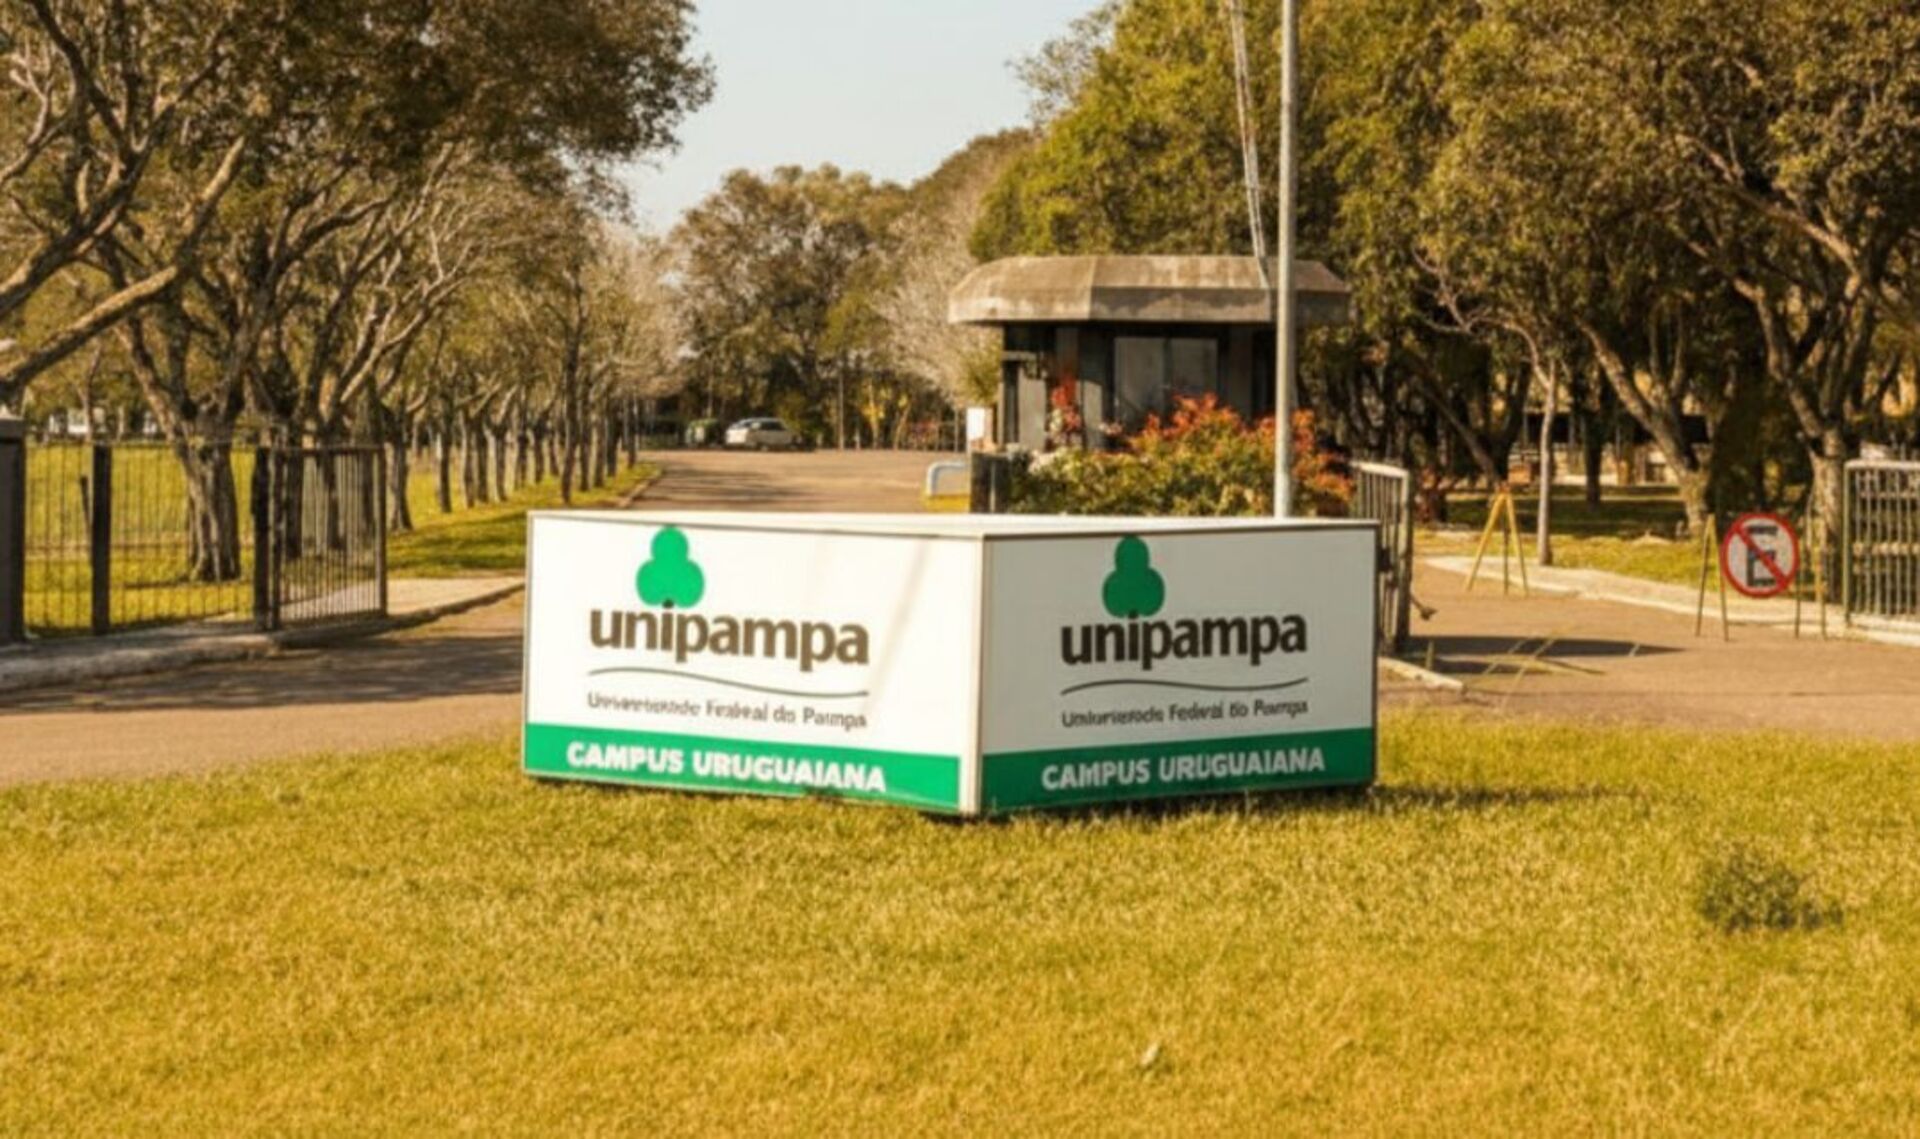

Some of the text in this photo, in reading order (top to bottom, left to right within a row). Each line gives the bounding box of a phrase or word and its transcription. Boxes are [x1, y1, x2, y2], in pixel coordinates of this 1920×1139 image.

[591, 600, 869, 671] unipampa
[1061, 611, 1306, 670] unipampa
[567, 741, 886, 792] CAMPUS URUGUAIANA
[1042, 748, 1325, 789] CAMPUS URUGUAIANA
